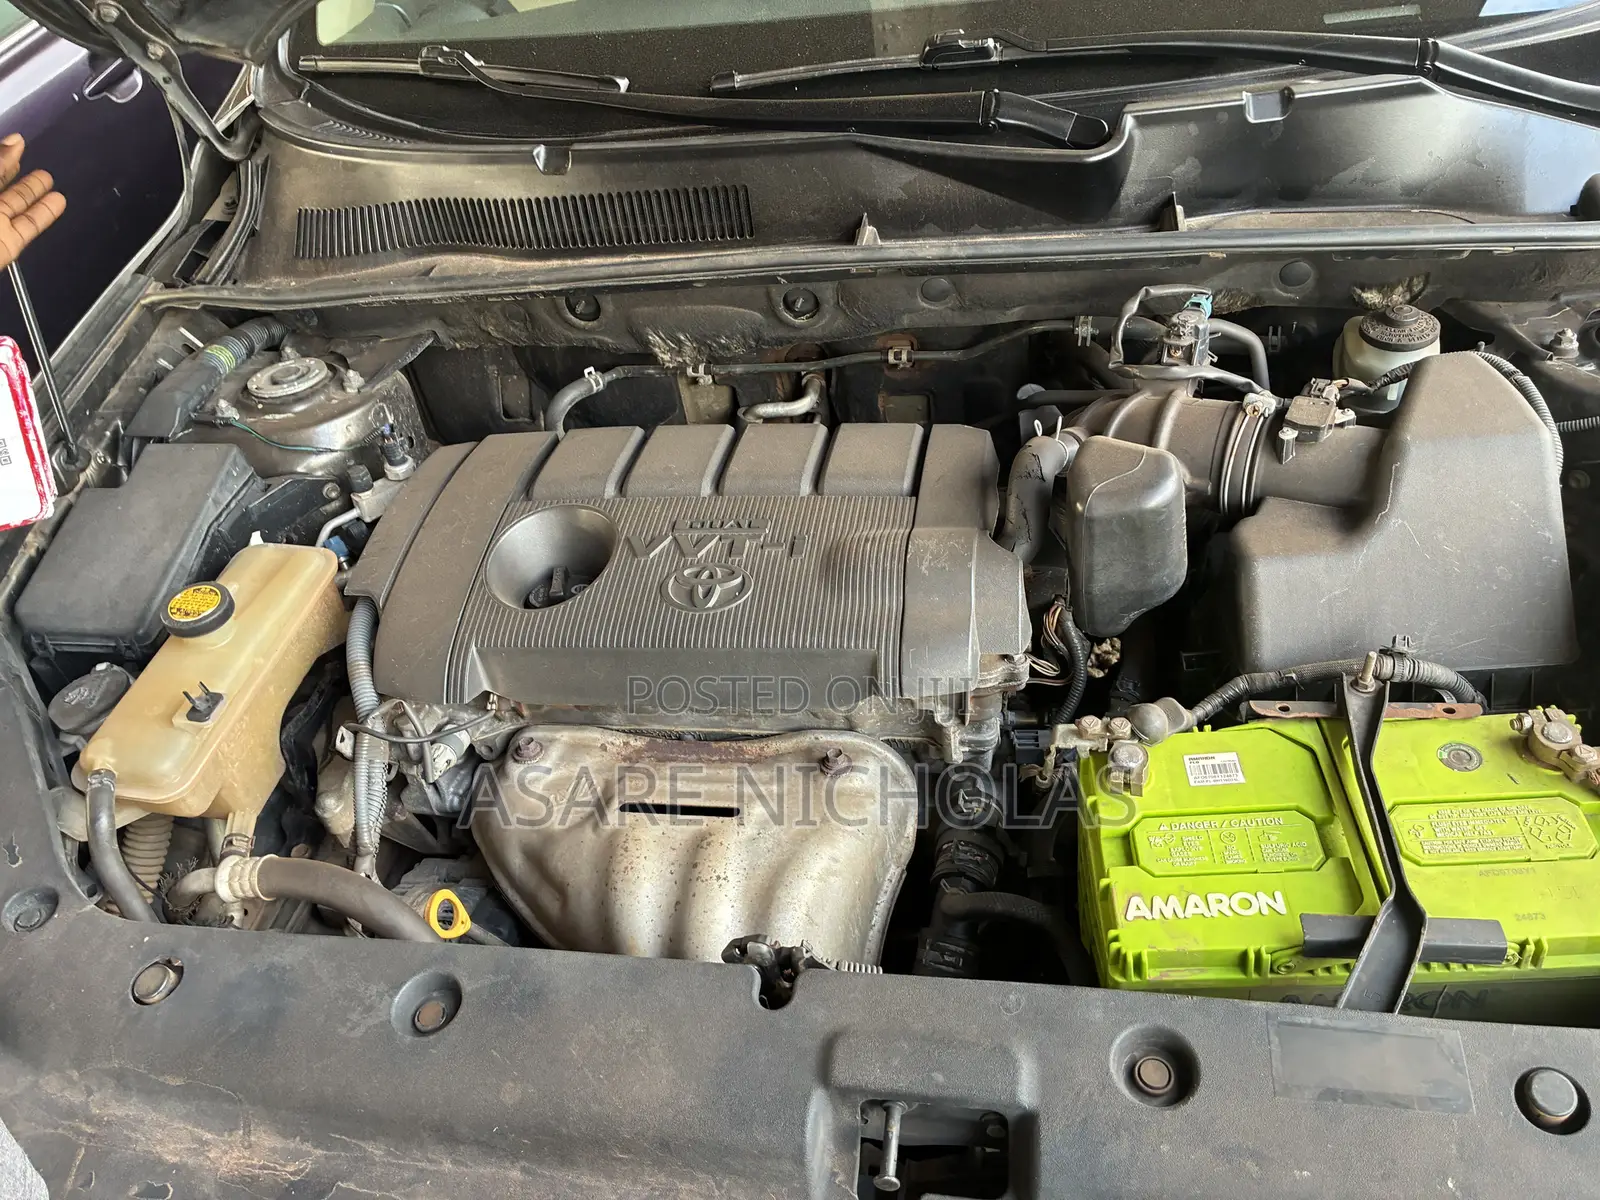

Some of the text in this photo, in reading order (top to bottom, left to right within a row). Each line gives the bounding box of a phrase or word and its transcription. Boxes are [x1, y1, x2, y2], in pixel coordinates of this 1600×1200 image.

[689, 519, 760, 529] DUAL
[1170, 821, 1219, 831] DANGER
[1230, 817, 1284, 827] CAUTION
[1125, 891, 1287, 921] AMARON
